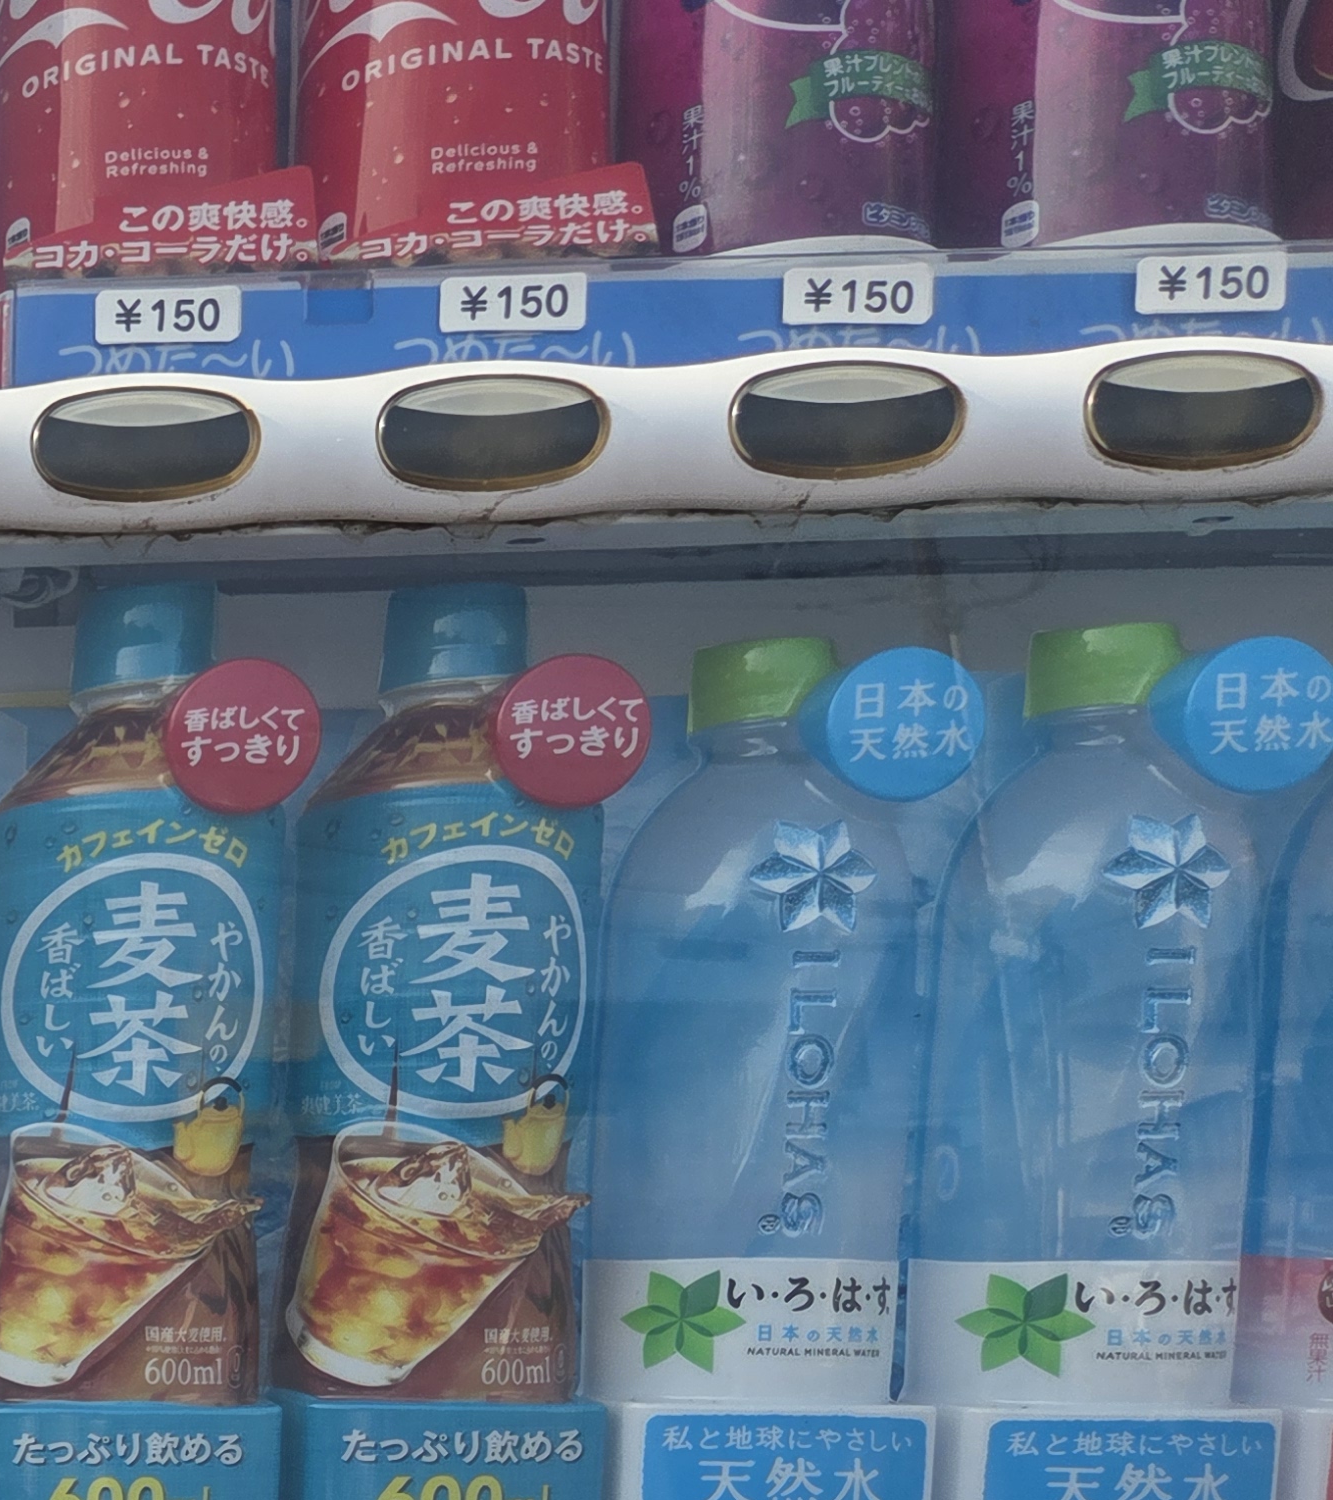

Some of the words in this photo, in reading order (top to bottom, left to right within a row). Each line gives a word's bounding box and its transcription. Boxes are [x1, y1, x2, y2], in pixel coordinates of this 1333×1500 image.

[22, 44, 183, 98] ORIGINAL
[197, 45, 269, 88] TASTE
[341, 38, 513, 92] ORIGINAL
[526, 38, 604, 75] TASTE
[105, 147, 192, 164] Delicious
[197, 147, 209, 160] &
[432, 143, 520, 160] Delicious
[433, 156, 537, 175] Refreshing
[106, 160, 207, 179] Refreshing
[119, 200, 309, 233] この爽快感。
[446, 188, 644, 225] この爽快感。
[35, 234, 310, 269] コカ・コーラだけ。
[361, 214, 648, 260] コカ・コーラだけ。
[803, 278, 915, 315] ¥150
[1157, 265, 1269, 301] ¥150
[114, 298, 221, 333] ¥150
[461, 283, 569, 320] ¥150
[855, 680, 969, 720] 日本の
[1216, 667, 1331, 711] 日本の
[184, 706, 305, 733] 香ばしくて
[511, 697, 644, 725] 香ばしくて
[181, 735, 301, 765] すっきり
[510, 726, 640, 759] すっきり
[849, 727, 972, 763] 天然水
[1210, 711, 1333, 755] 天然水
[57, 819, 248, 872] カフェインゼロ
[381, 811, 576, 865] カフェインゼロ
[36, 922, 82, 1056] 香ばしい
[77, 880, 203, 1096] 麦茶
[357, 916, 407, 1056] 香ばしい
[401, 873, 535, 1092] 麦茶
[757, 1324, 879, 1343] 日本の天然水
[1106, 1327, 1227, 1347] 日本の天然水
[747, 1347, 799, 1357] NATURAL
[803, 1347, 851, 1358] MINERAL
[1306, 1333, 1330, 1384] 無果汁
[145, 1358, 223, 1385] 600ml
[481, 1359, 550, 1385] 600ml
[12, 1432, 244, 1465] たっぷり飲める
[342, 1429, 583, 1463] たっぷり飲める
[663, 1425, 913, 1453] 私と地球にやさしい
[1007, 1430, 1263, 1458] 私と地球にやさしい
